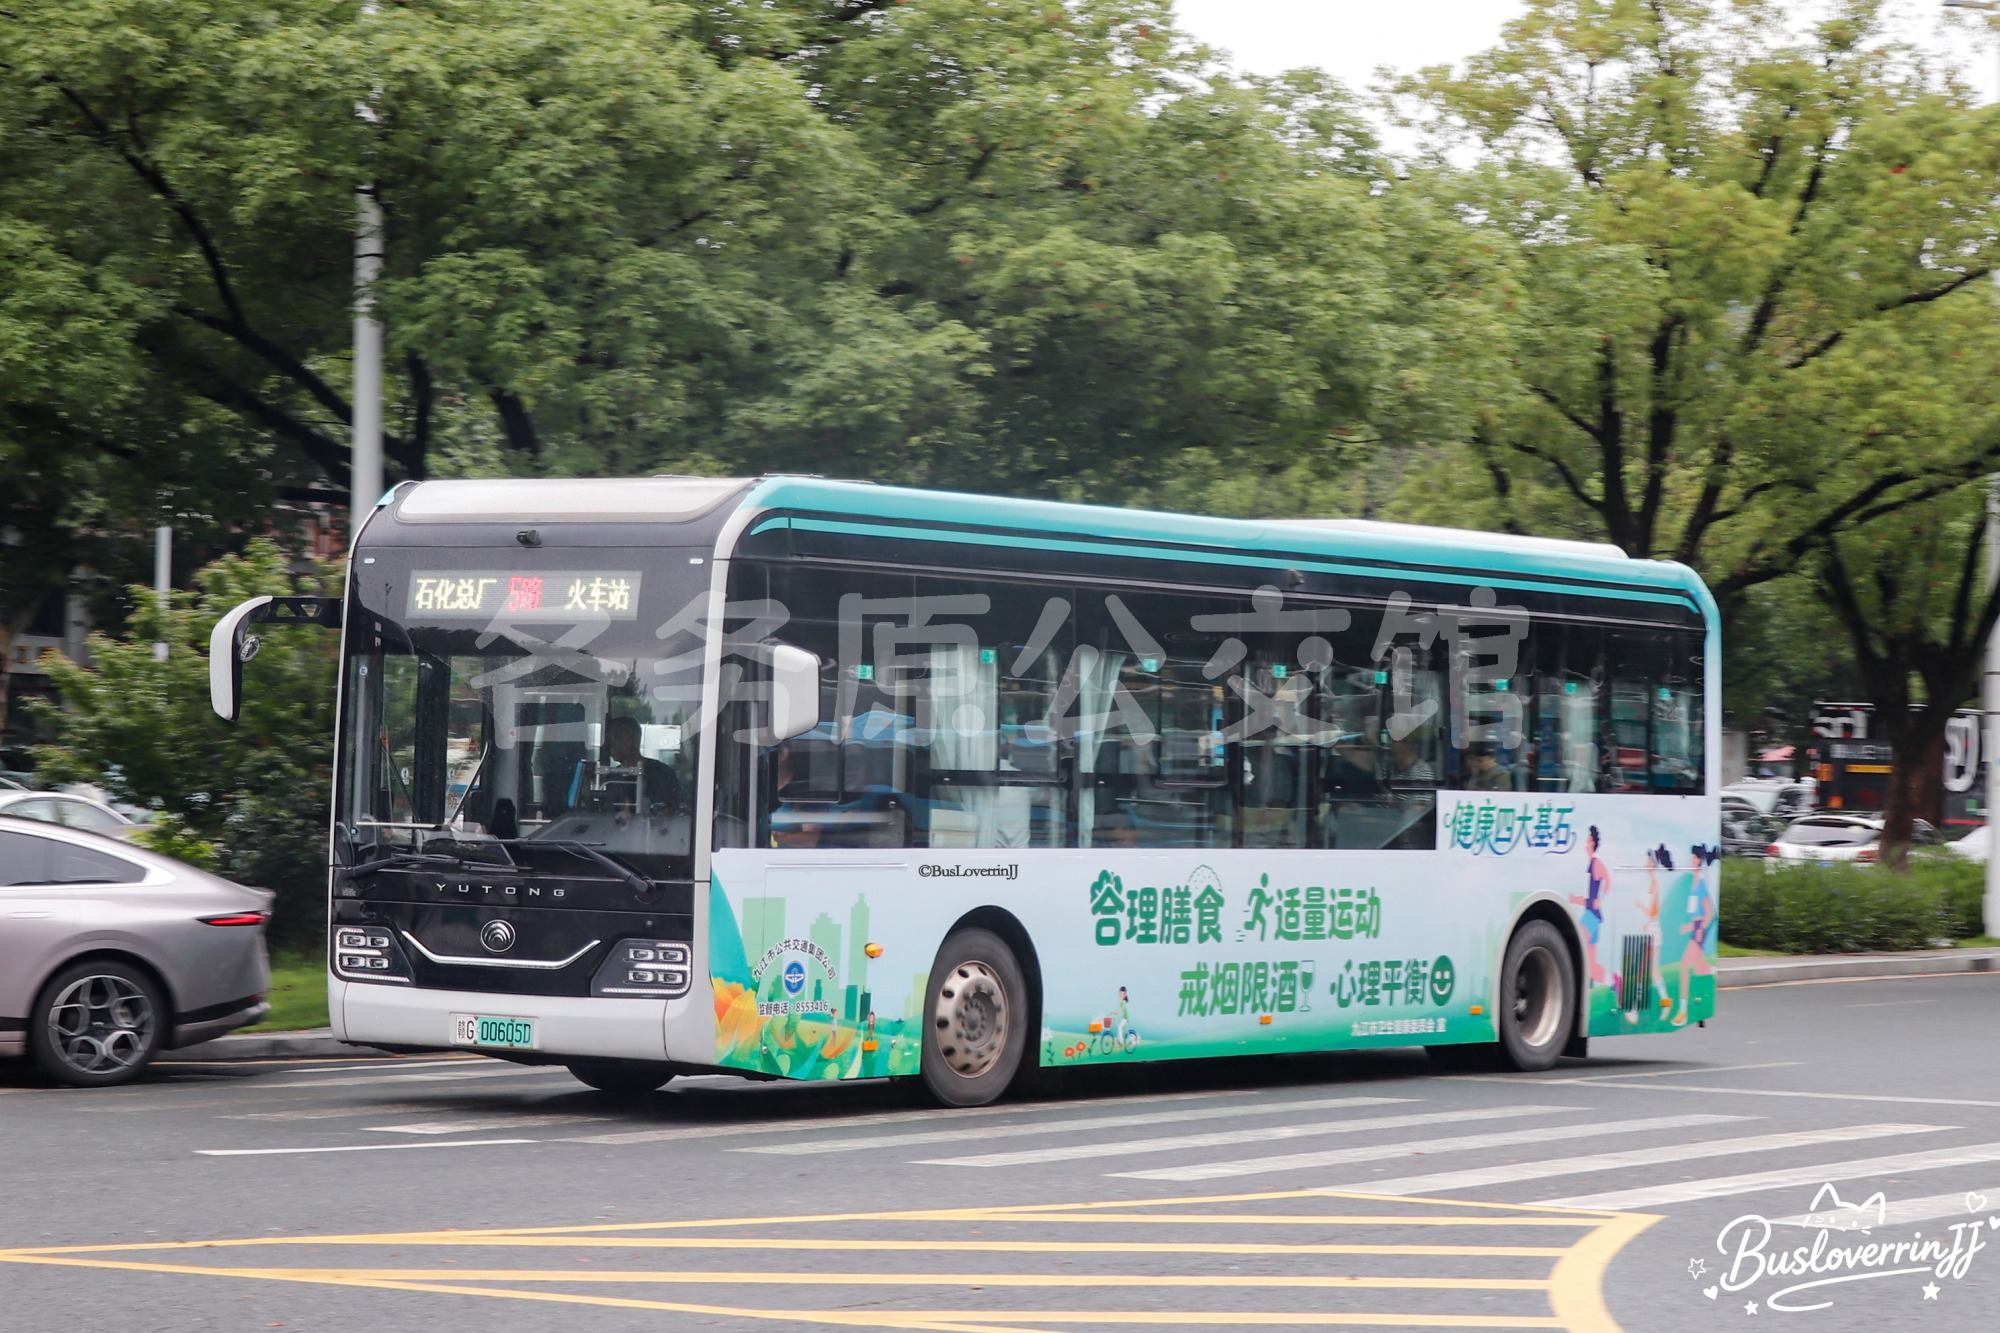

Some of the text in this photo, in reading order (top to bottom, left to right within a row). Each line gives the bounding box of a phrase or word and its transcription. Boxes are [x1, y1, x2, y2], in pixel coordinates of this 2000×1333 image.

[415, 577, 497, 610] 石化总厂
[565, 577, 631, 611] 火车站
[1443, 799, 1577, 856] 健康四大基石
[436, 883, 565, 898] YUTONG
[1089, 870, 1382, 946] 合理膳食 适量运动
[752, 938, 837, 982] 九江市公共交通集团公司
[1178, 957, 1429, 1018] 戒烟限酒 心理平衡
